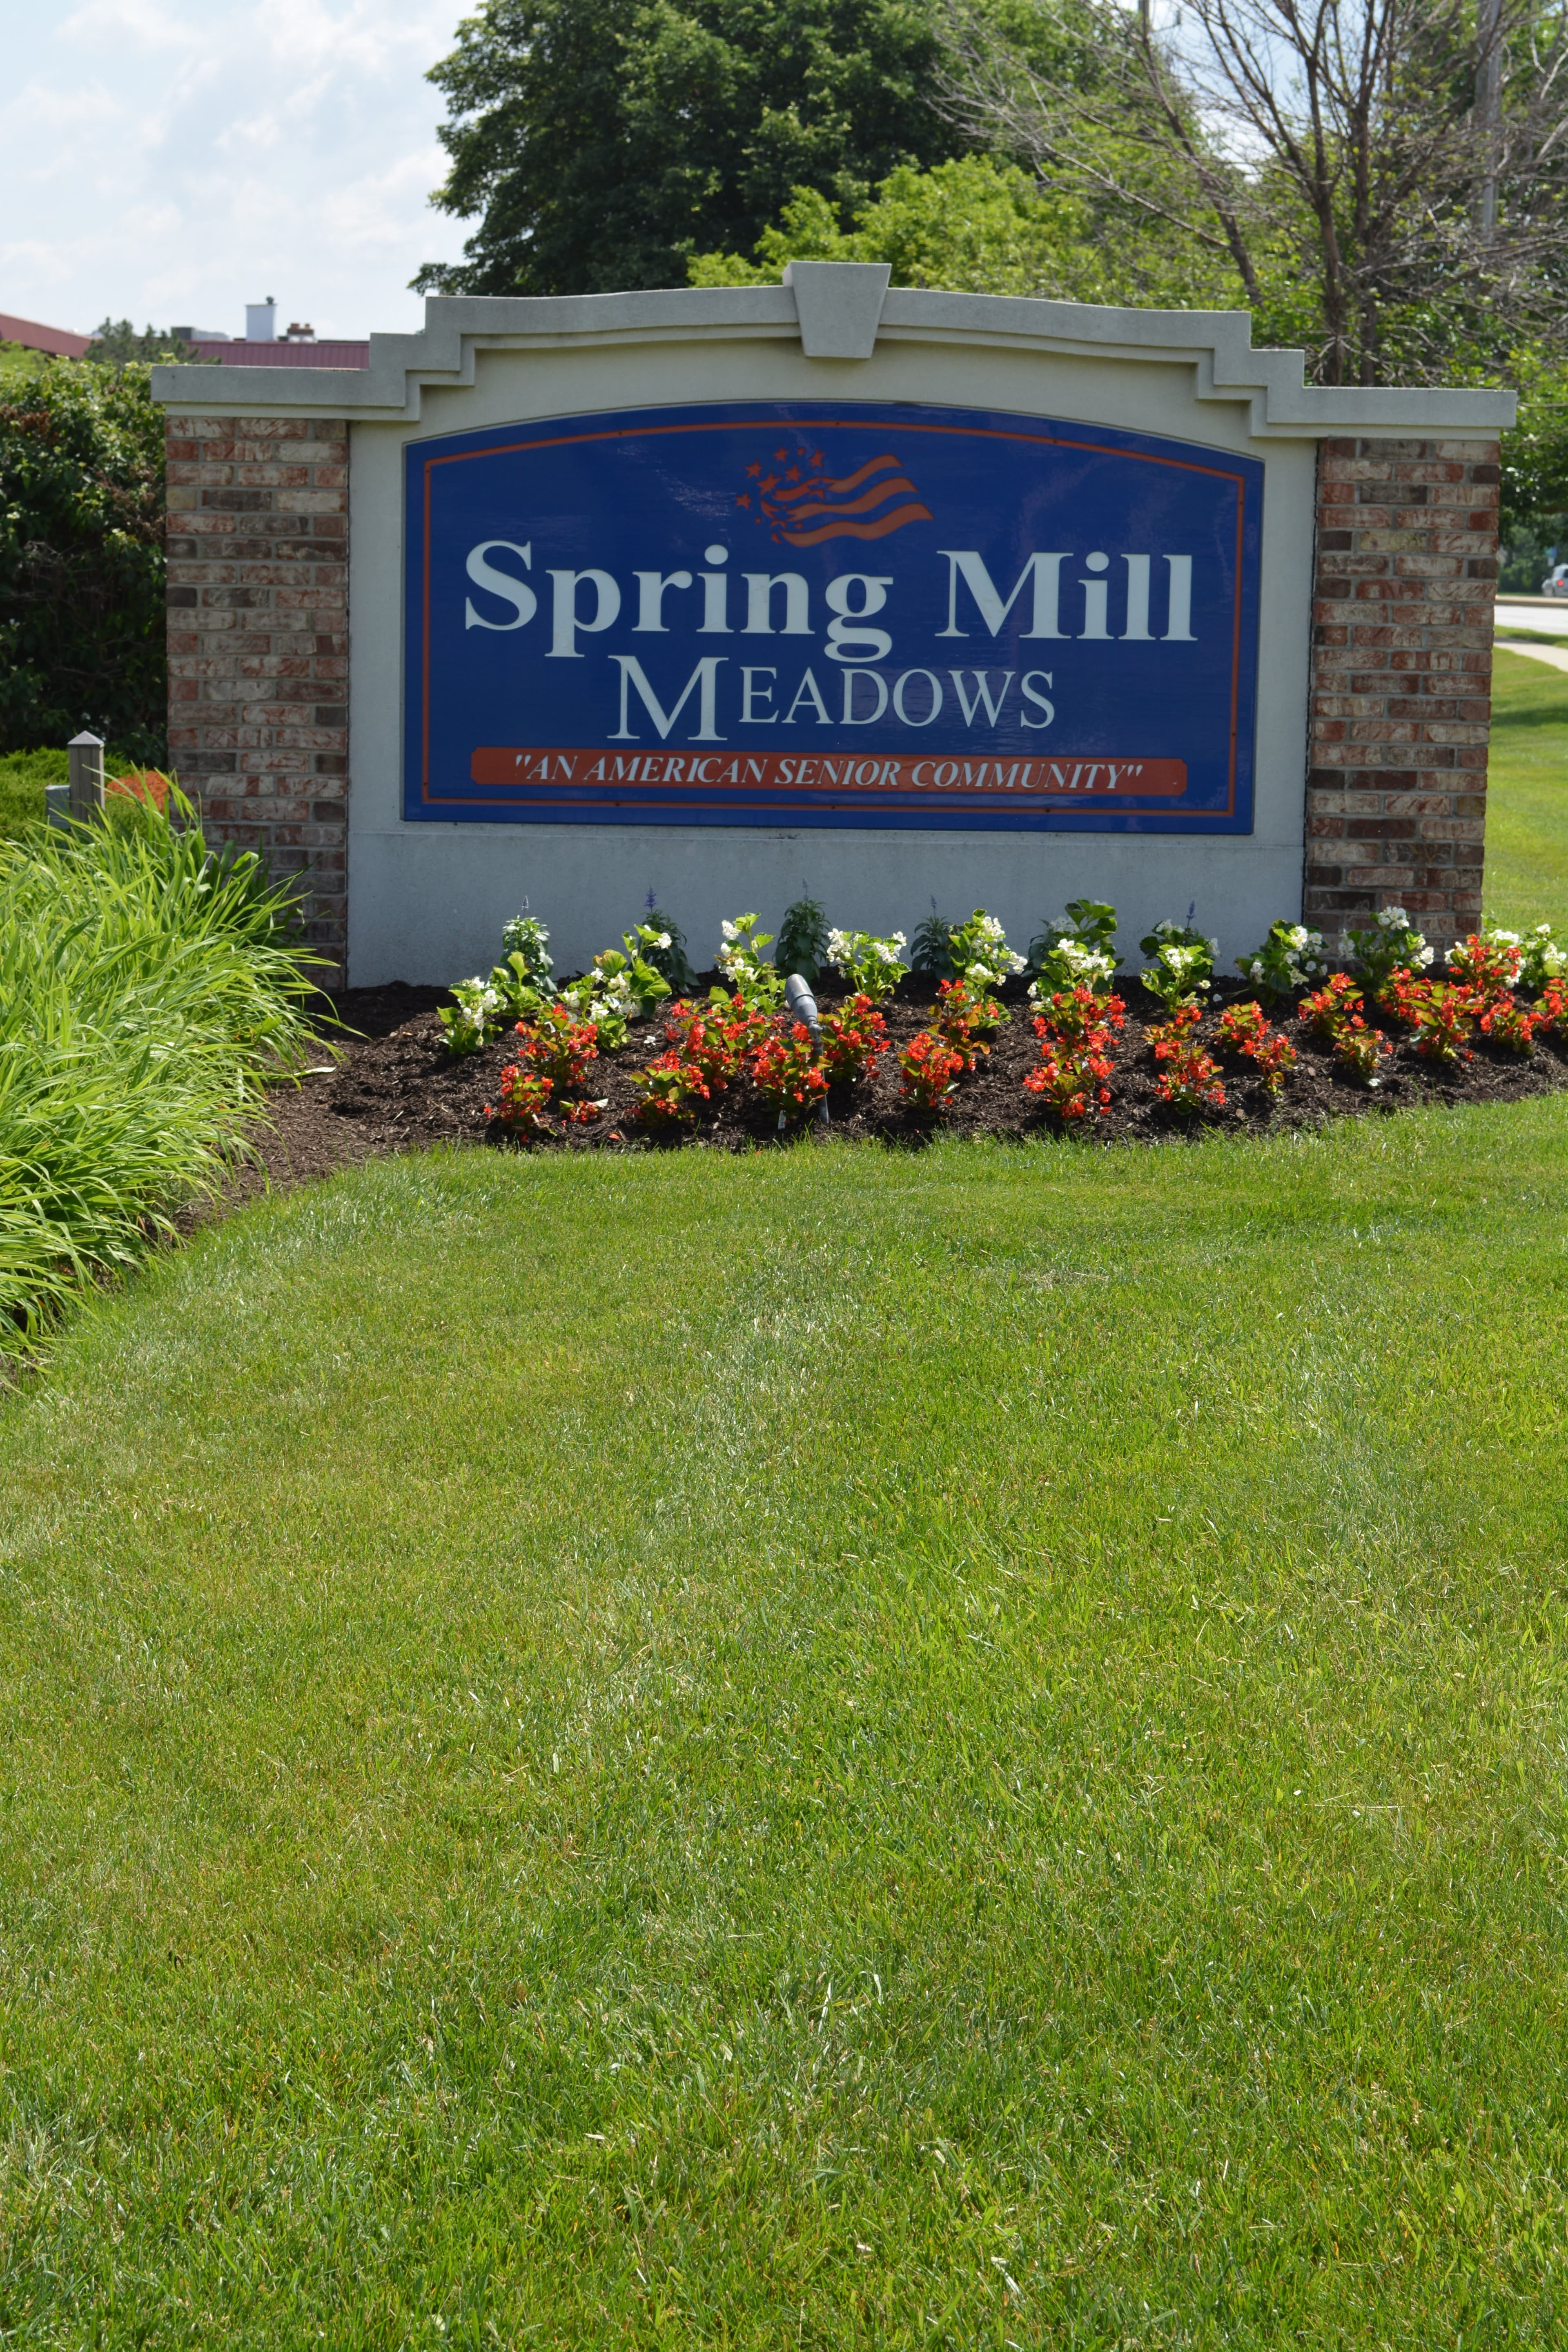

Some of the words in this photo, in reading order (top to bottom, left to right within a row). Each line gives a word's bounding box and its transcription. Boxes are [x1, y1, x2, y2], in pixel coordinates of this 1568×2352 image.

[465, 540, 894, 663] Spring
[934, 550, 1198, 641] Mill
[606, 655, 1055, 741] MEADOWS
[515, 755, 577, 780] "AN
[584, 757, 768, 783] AMERICAN
[775, 759, 901, 786] SENIOR
[911, 761, 1143, 789] COMMUNITY"
